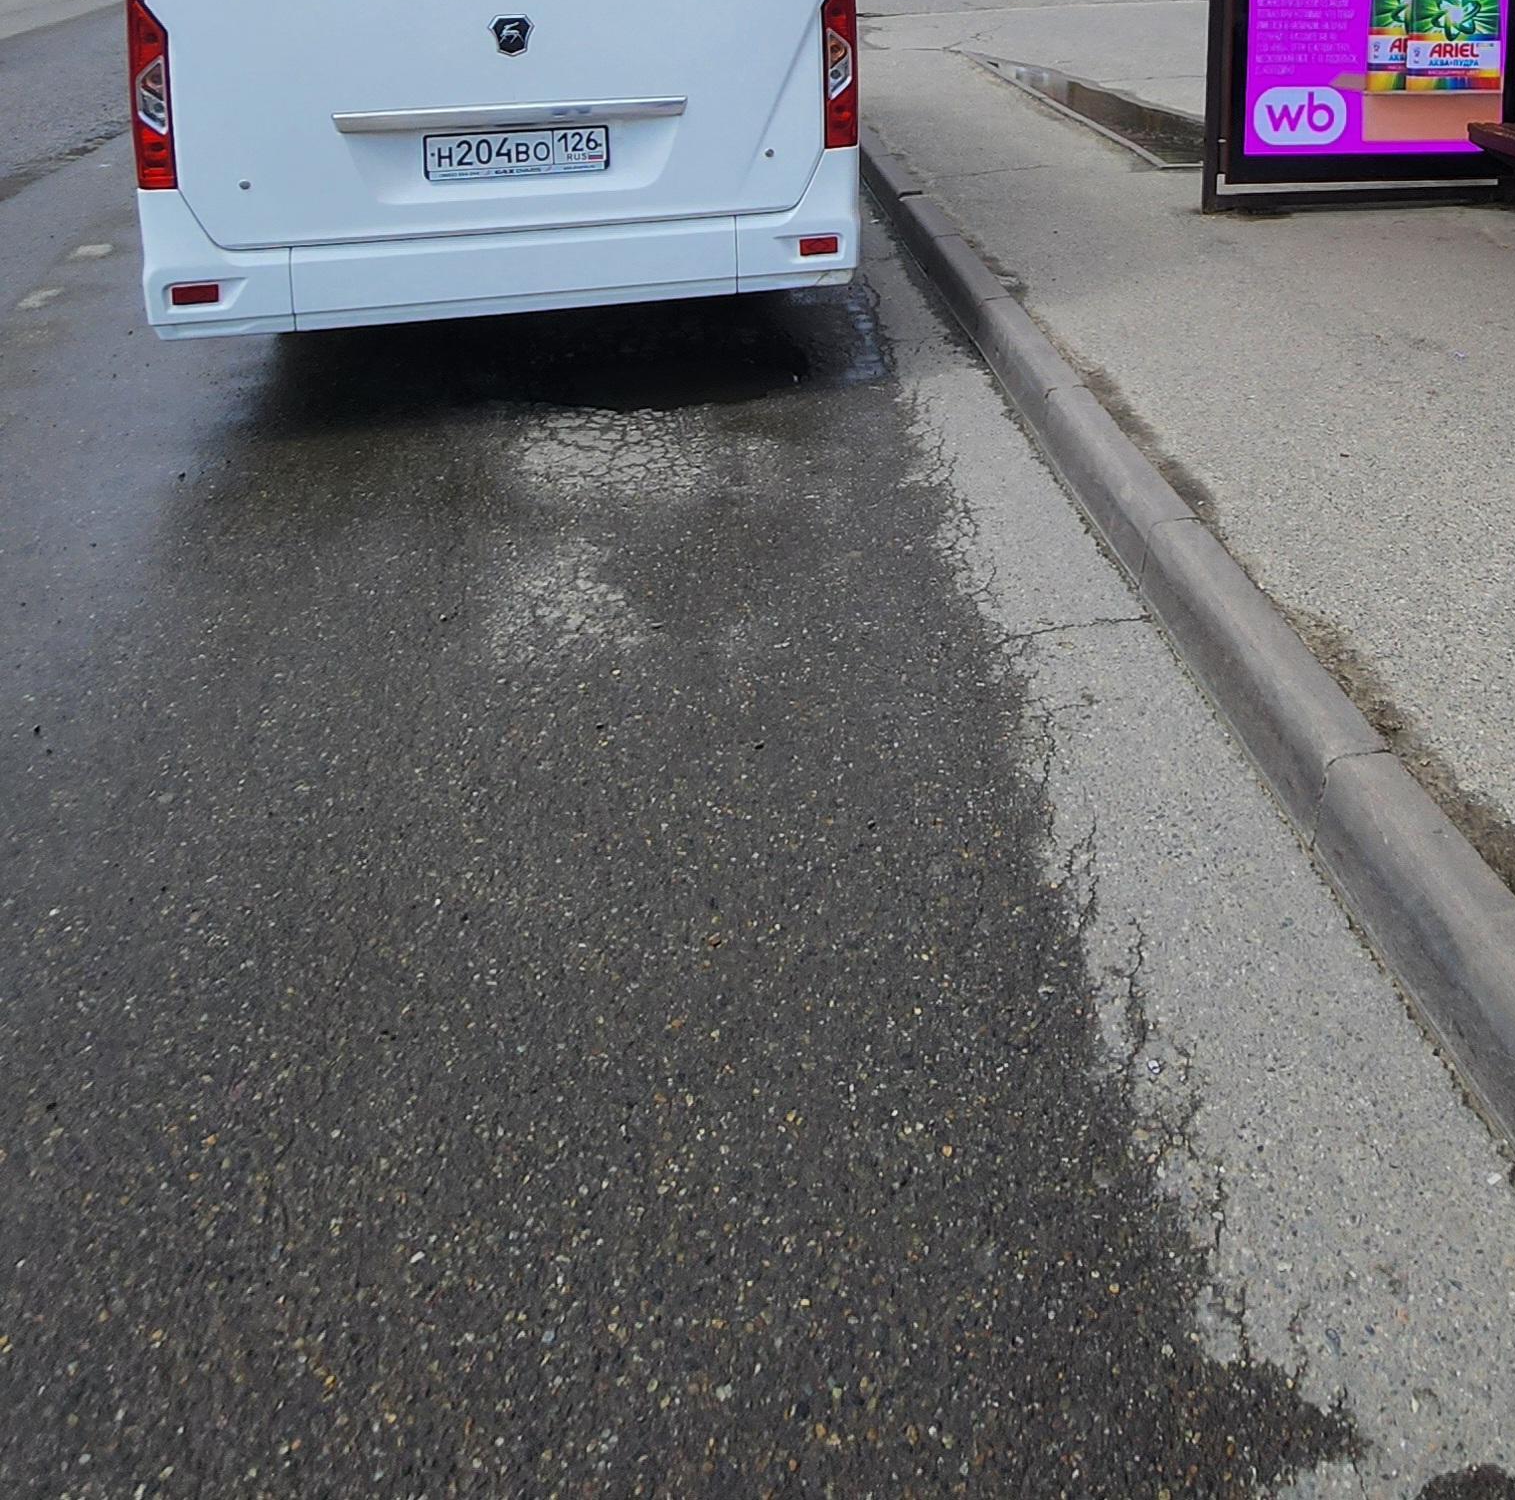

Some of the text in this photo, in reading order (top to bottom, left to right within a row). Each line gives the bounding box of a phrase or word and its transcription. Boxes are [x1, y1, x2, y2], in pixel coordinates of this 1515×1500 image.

[1429, 42, 1480, 58] ARIEL
[1265, 91, 1335, 132] wb
[437, 131, 598, 168] Н204ВО 126
[566, 152, 587, 161] RUS
